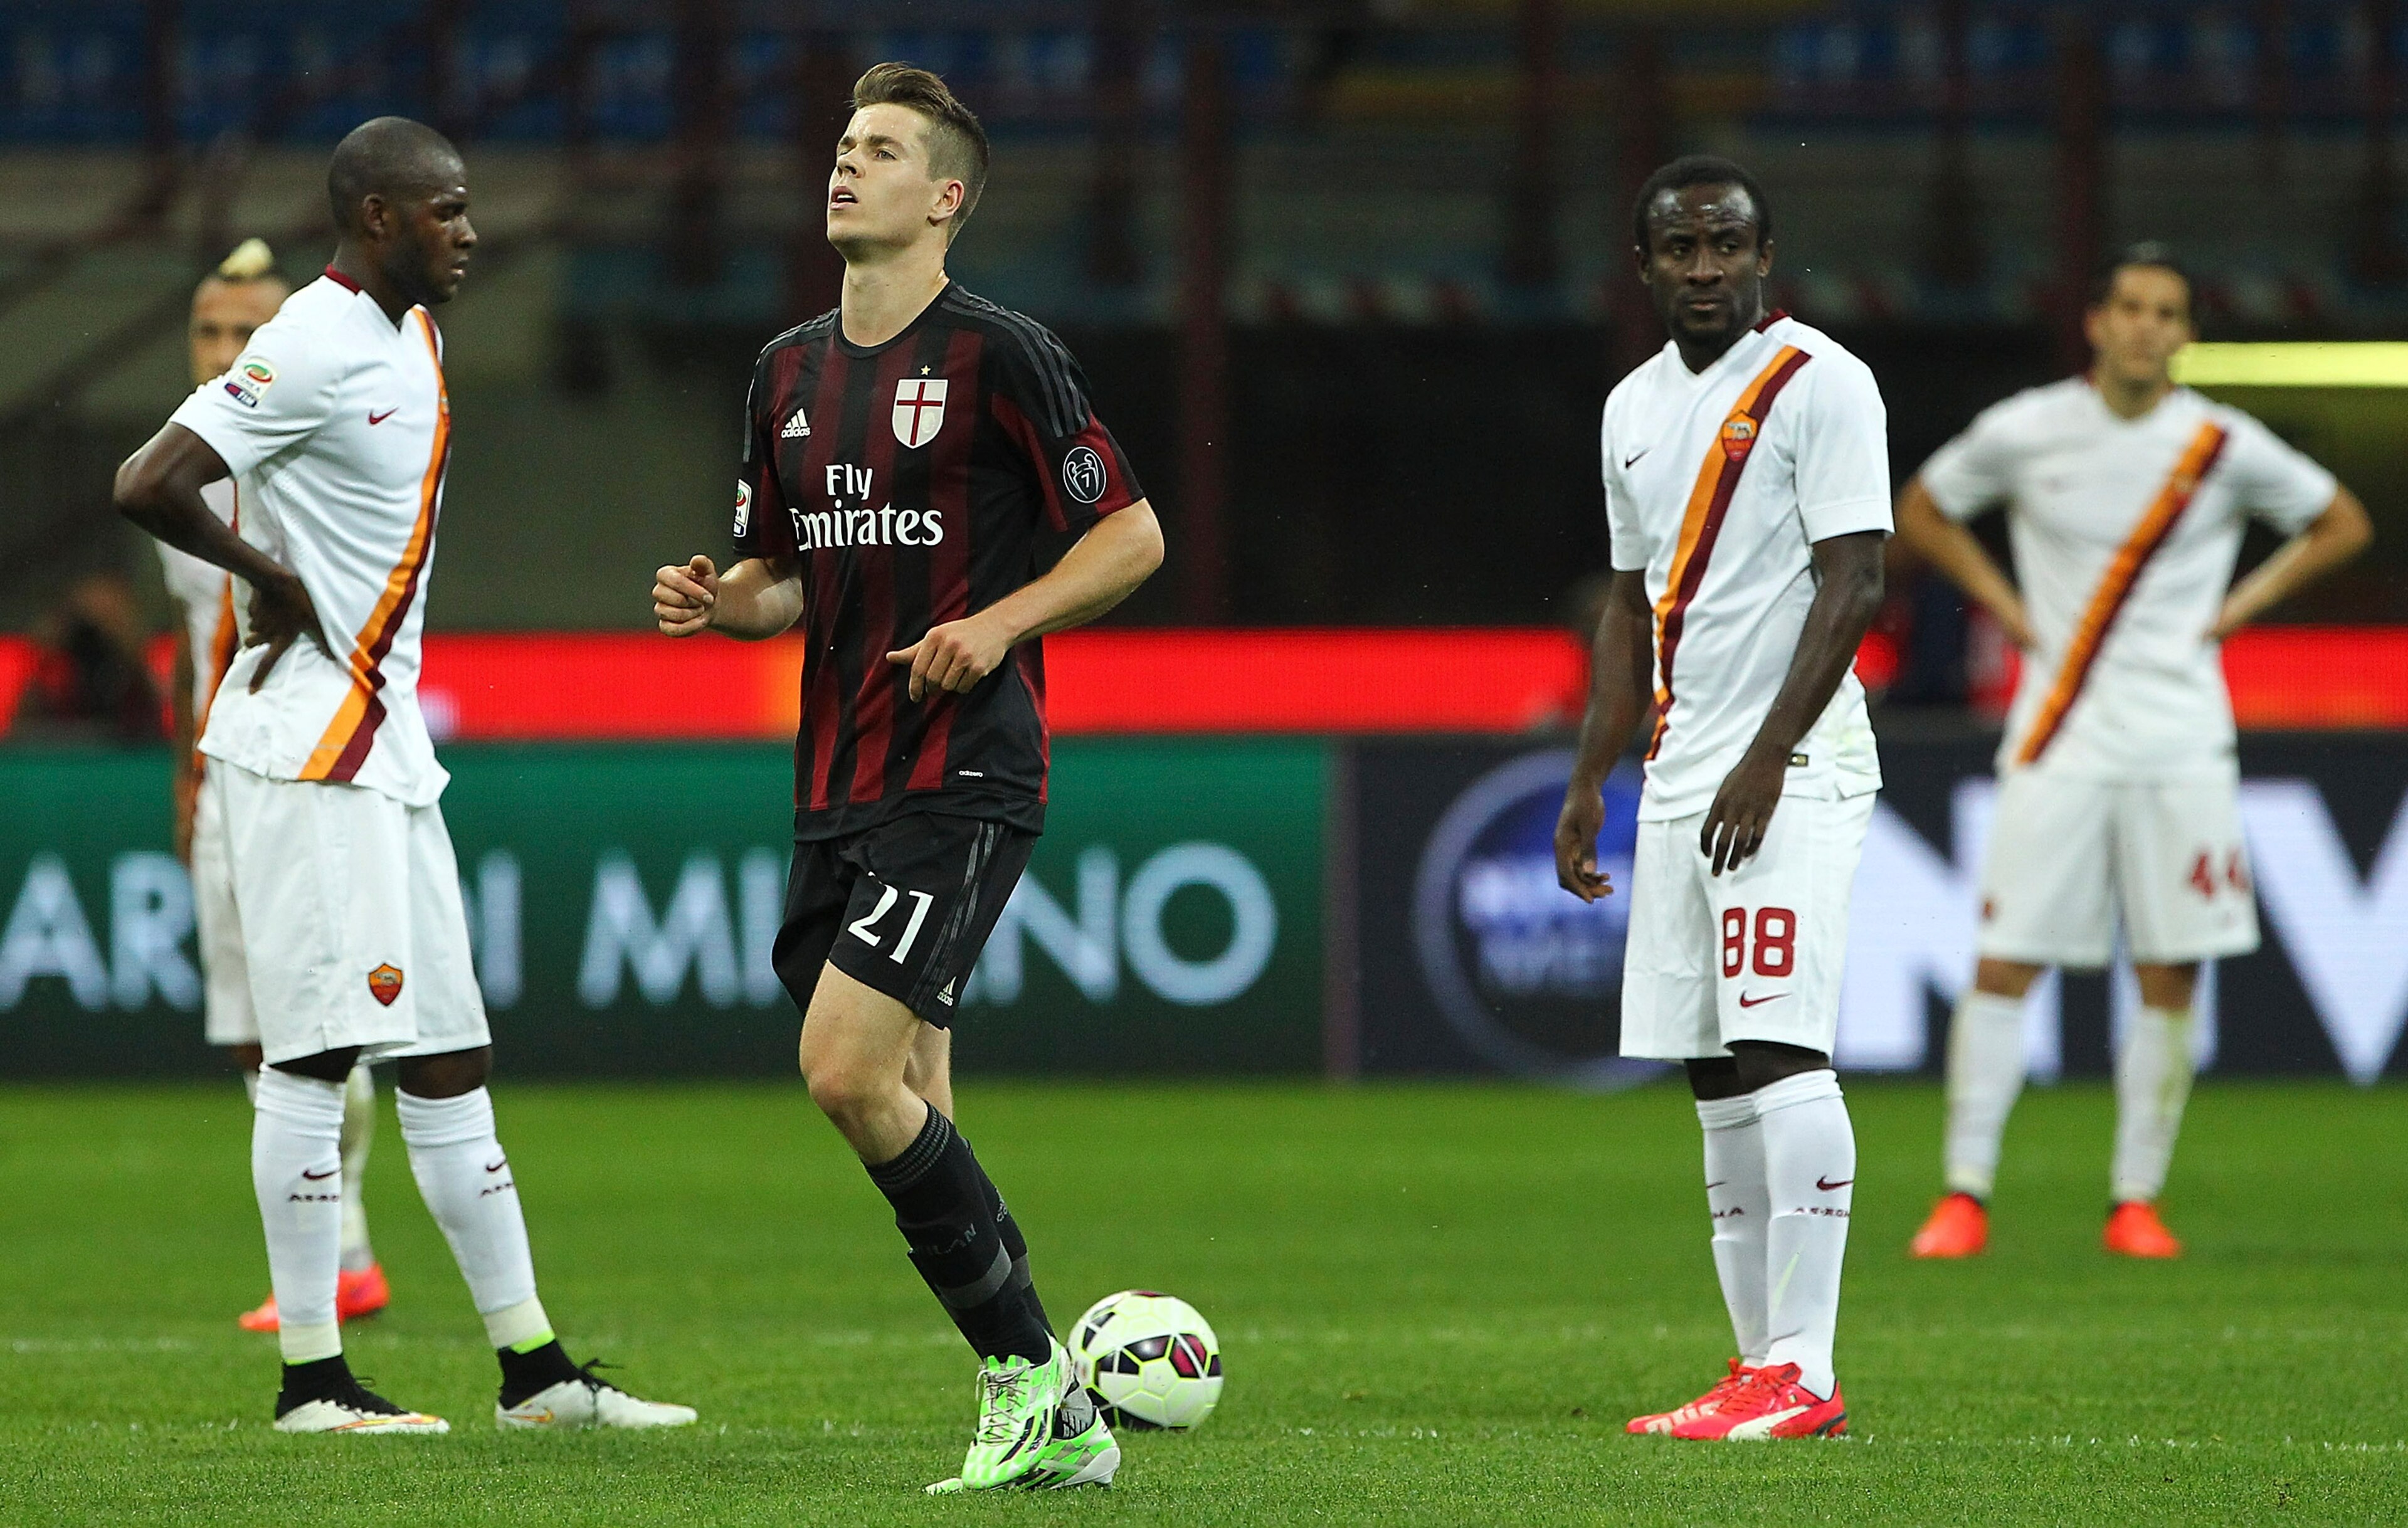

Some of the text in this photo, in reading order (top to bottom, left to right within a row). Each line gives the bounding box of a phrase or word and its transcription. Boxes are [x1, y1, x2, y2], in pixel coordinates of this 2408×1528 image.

[781, 427, 811, 438] adidas
[825, 463, 874, 500] Fly
[1080, 472, 1090, 488] 7
[788, 499, 944, 552] Emirates
[577, 841, 1278, 1008] MINO
[848, 871, 934, 964] 21
[1723, 907, 1796, 978] 88
